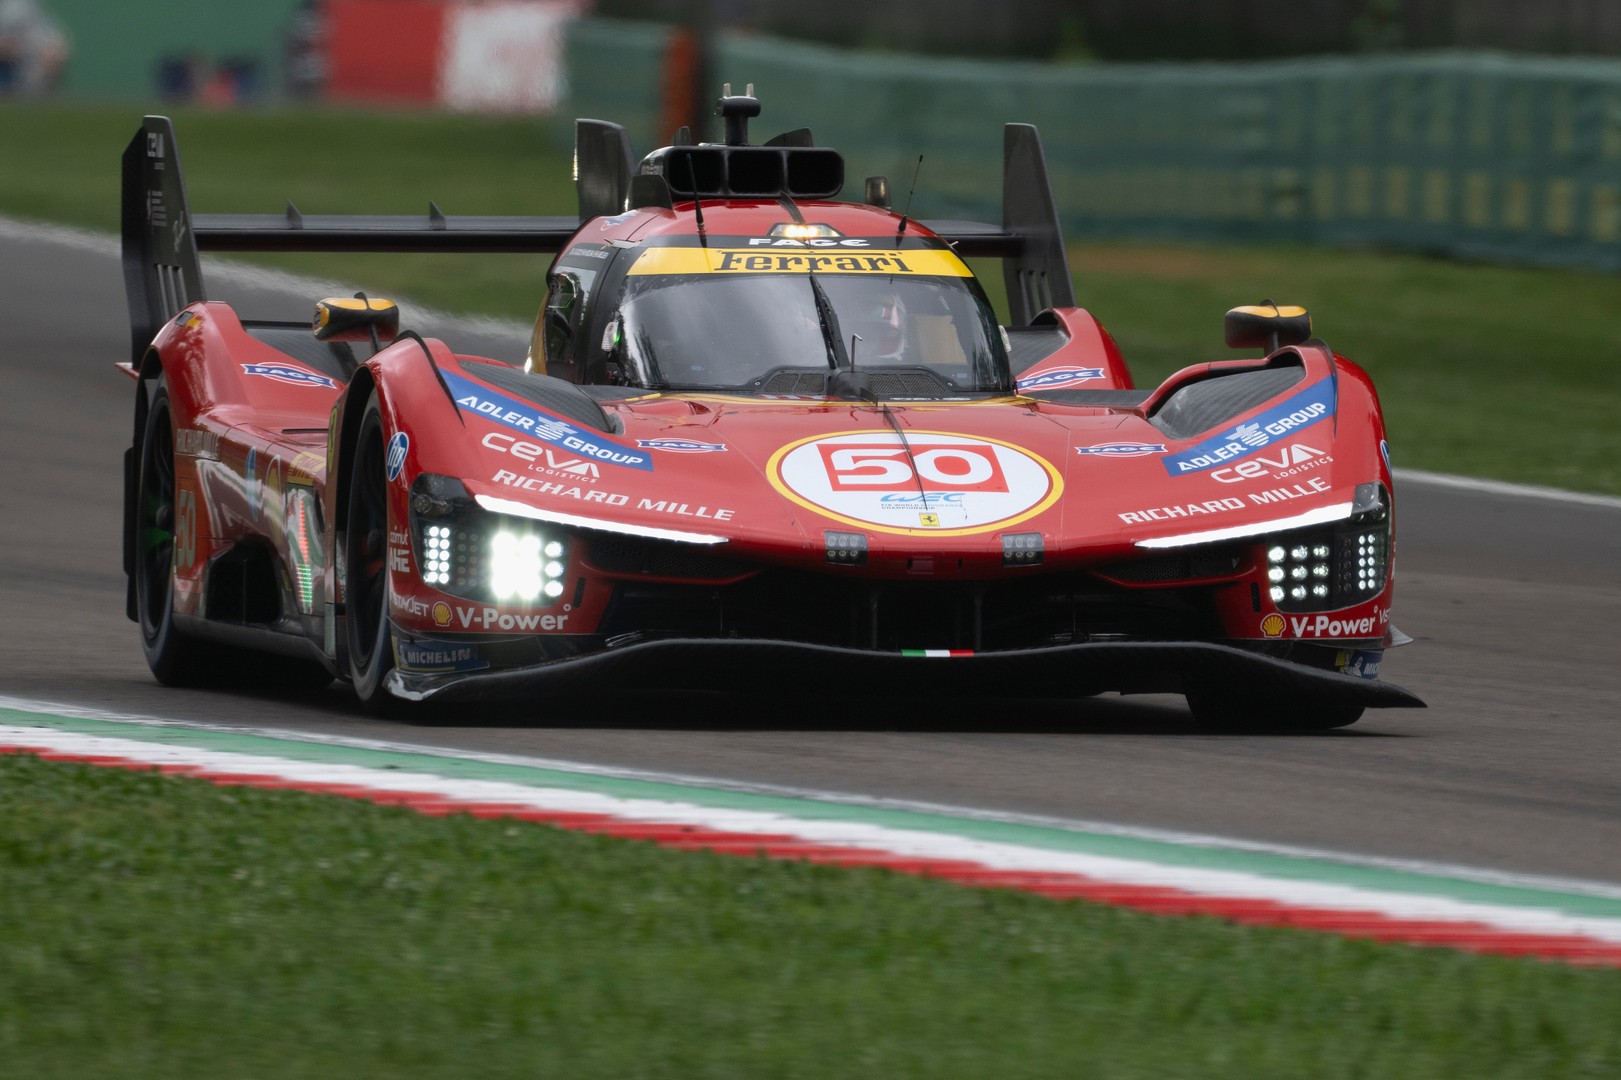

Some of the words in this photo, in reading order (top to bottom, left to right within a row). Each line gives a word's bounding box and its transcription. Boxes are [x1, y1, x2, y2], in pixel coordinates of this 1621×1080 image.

[713, 250, 913, 273] Ferrari
[254, 367, 325, 384] FAGE
[1021, 370, 1095, 387] FAGE
[457, 396, 534, 429] ADLER
[562, 436, 644, 466] GROUP
[1177, 442, 1248, 472] ADLER
[1264, 402, 1326, 437] GROUP
[527, 464, 597, 484] LOGISTICS
[830, 449, 994, 485] 50
[1273, 455, 1334, 480] LOGISTICS
[491, 469, 630, 506] RICHARD
[637, 498, 736, 521] MILLE
[880, 492, 965, 502] WEC
[1118, 497, 1245, 525] RICHARD
[1248, 476, 1332, 505] MILLE
[456, 606, 569, 630] V-Power
[1292, 615, 1375, 637] V-Power
[407, 647, 471, 664] MICHELIN
